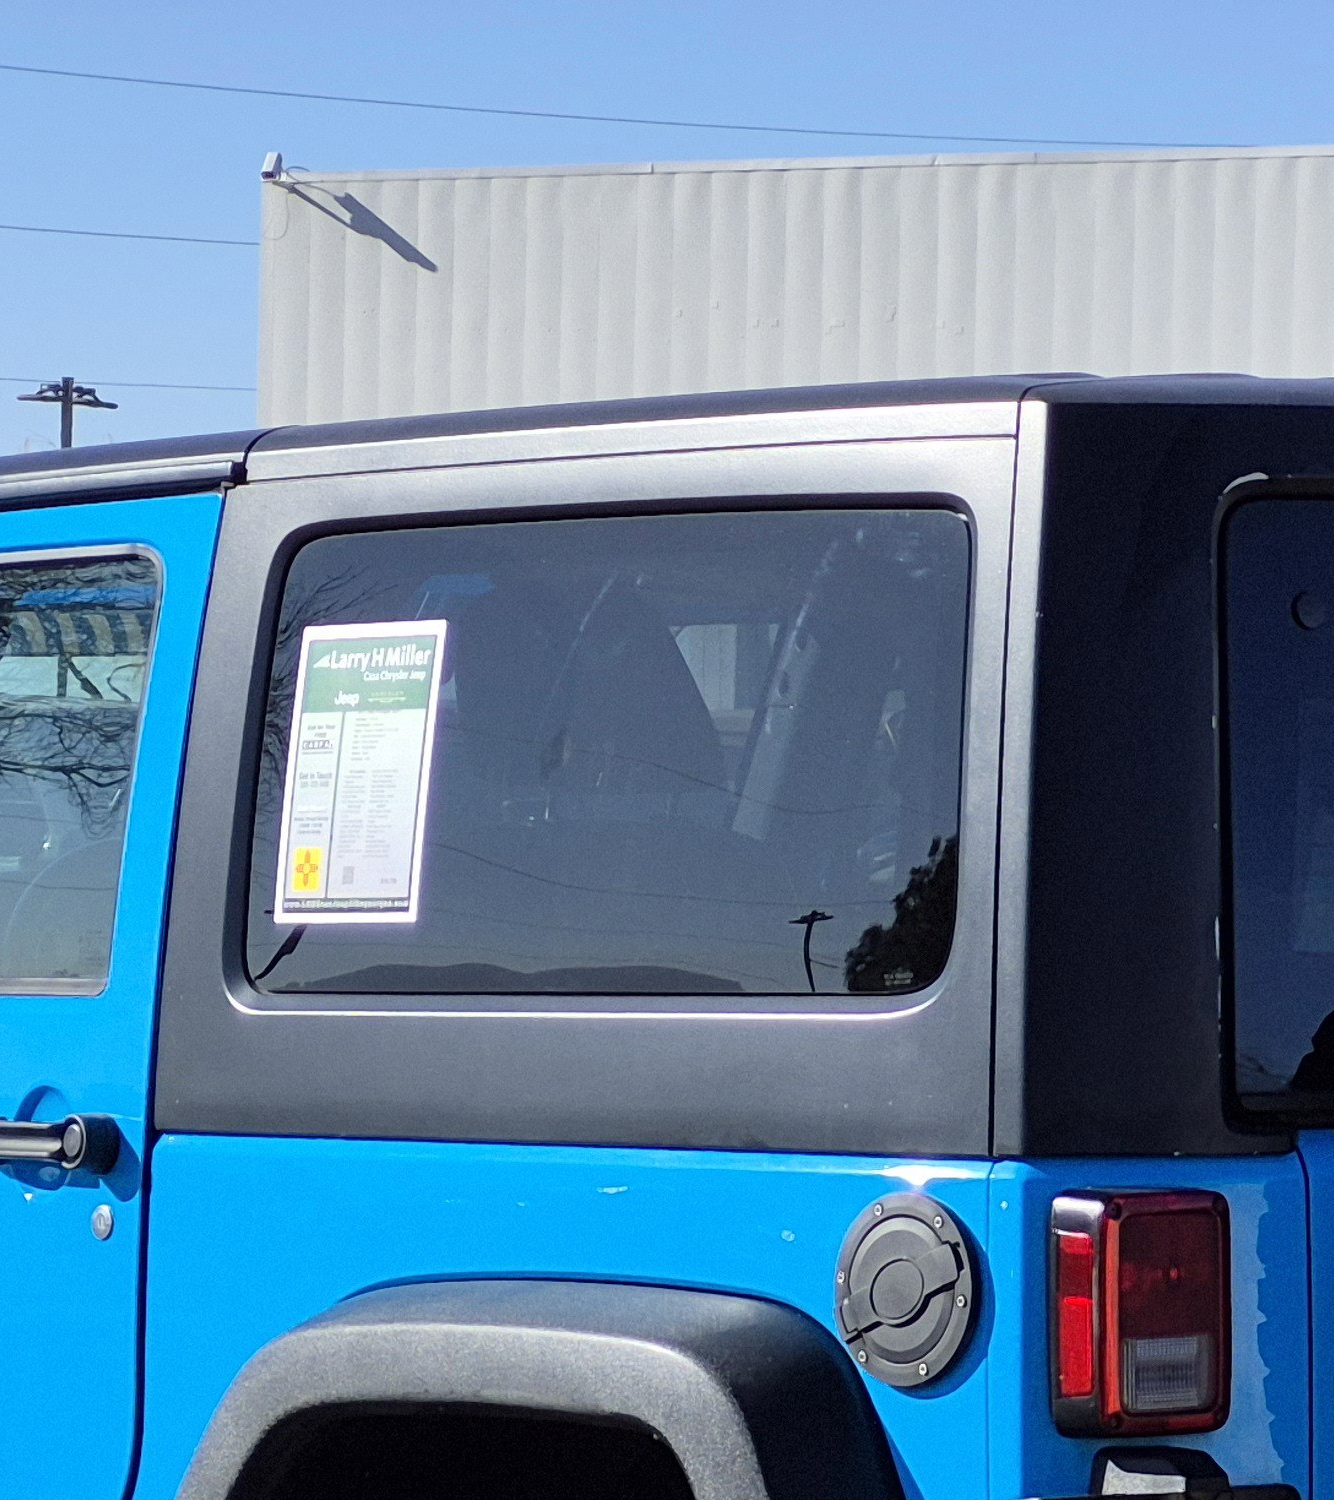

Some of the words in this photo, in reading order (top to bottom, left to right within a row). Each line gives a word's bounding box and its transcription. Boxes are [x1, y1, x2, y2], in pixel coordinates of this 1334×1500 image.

[330, 650, 370, 672] Larry
[371, 648, 384, 667] H
[385, 644, 431, 667] Miller
[334, 690, 360, 707] Jeep
